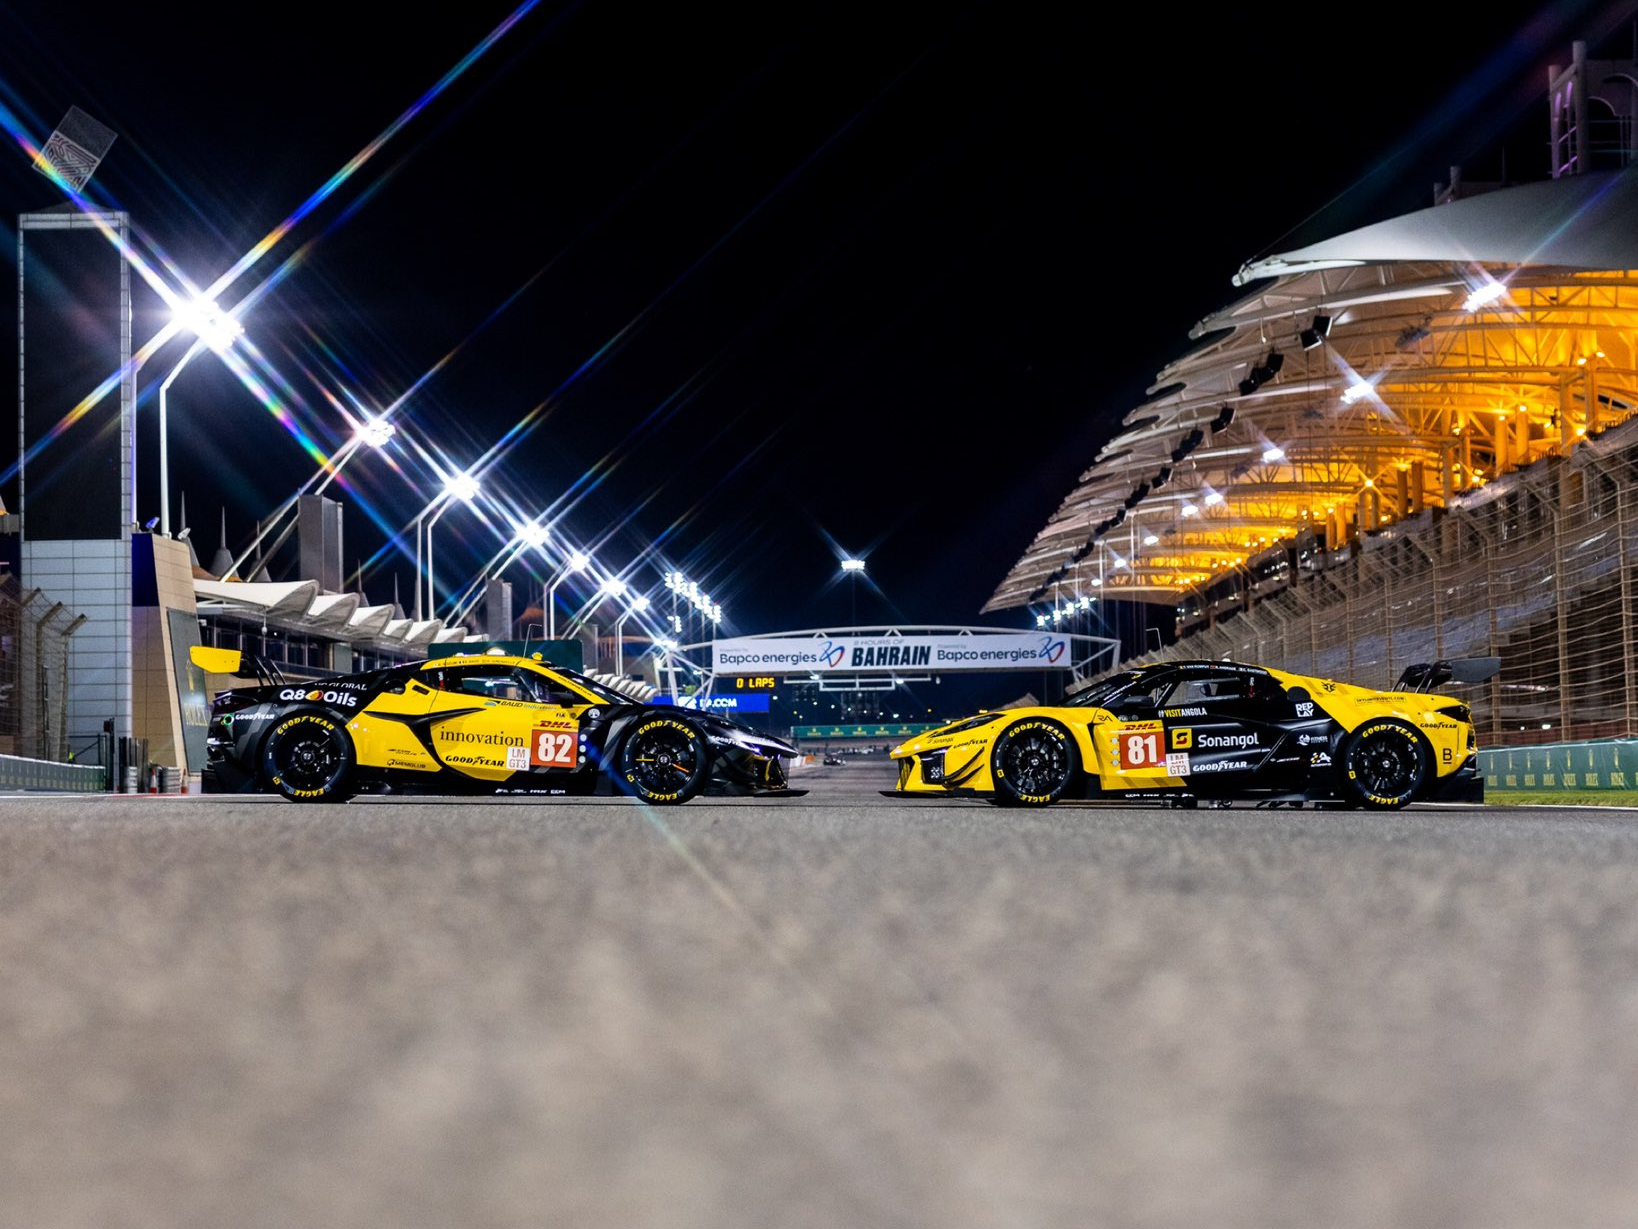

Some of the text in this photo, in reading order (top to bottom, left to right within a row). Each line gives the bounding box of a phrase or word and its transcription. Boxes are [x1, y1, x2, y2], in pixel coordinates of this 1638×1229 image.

[720, 651, 817, 666] Bapco energies
[852, 646, 931, 667] BAHRAIN
[937, 647, 1037, 662] Bapco energies
[749, 677, 775, 688] LAPS
[280, 689, 357, 707] Q8 Oils
[501, 700, 523, 708] BAUD
[1295, 702, 1314, 711] REP
[235, 713, 275, 721] GOODYEAR
[1158, 707, 1208, 718] #VISITANGOLA
[1297, 709, 1314, 718] LAY
[540, 720, 573, 729] DHL
[1125, 722, 1157, 731] DHL
[1419, 721, 1458, 730] GOODYEAR
[440, 726, 524, 748] innovation
[1198, 732, 1259, 749] Sonangol
[538, 732, 573, 763] 82
[1127, 735, 1157, 765] 81
[511, 748, 526, 759] LM
[1442, 748, 1453, 762] B
[445, 755, 505, 768] GOODYEAR
[509, 758, 527, 769] GT3
[1192, 760, 1248, 772] GOODYEAR
[1170, 765, 1187, 775] GT3
[294, 787, 324, 798] EAGLE
[647, 791, 678, 801] EAGLE
[1020, 794, 1051, 803] EAGLE
[1368, 795, 1399, 805] EAGLE
